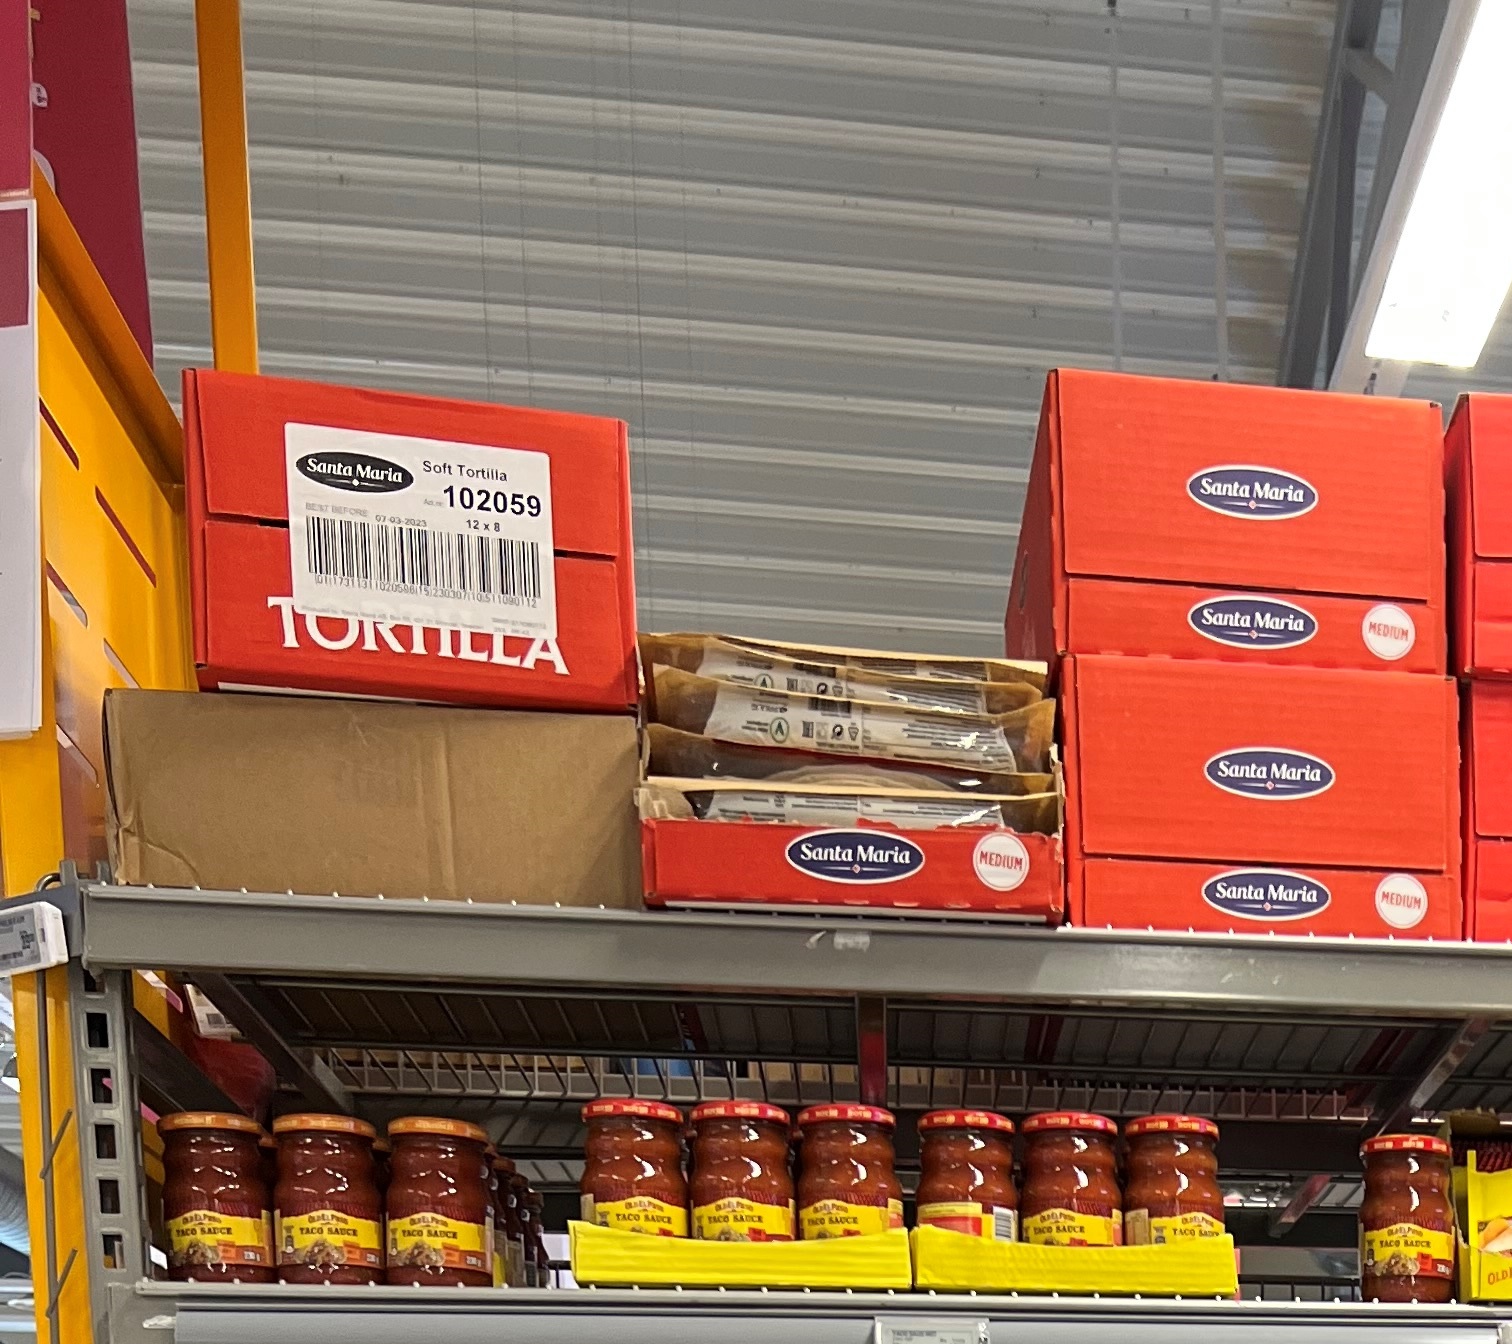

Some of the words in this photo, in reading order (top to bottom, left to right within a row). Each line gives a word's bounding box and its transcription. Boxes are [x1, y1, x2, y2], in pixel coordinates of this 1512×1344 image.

[423, 461, 452, 475] Soft
[457, 465, 507, 481] Tortilla
[1200, 478, 1249, 497] Santa
[1252, 482, 1304, 502] Maria
[443, 486, 541, 517] 102059
[466, 519, 479, 530] 12
[483, 522, 490, 531] x
[494, 522, 500, 532] 8
[1368, 620, 1409, 642] MEDIUM
[979, 850, 1024, 870] MEDIUM
[1382, 890, 1422, 912] MEDIUM
[616, 1213, 640, 1222] TACO
[644, 1213, 672, 1224] SAUCE
[708, 1214, 730, 1224] TACO
[733, 1214, 764, 1223] SAUCE
[176, 1227, 197, 1237] TACO
[199, 1227, 232, 1237] SAUCE
[299, 1227, 321, 1237] TACO
[324, 1227, 358, 1238] SAUCE
[401, 1229, 424, 1239] TACO
[426, 1230, 458, 1239] SAUCE
[1033, 1226, 1053, 1234] TACO
[1056, 1225, 1085, 1234] SAUCE
